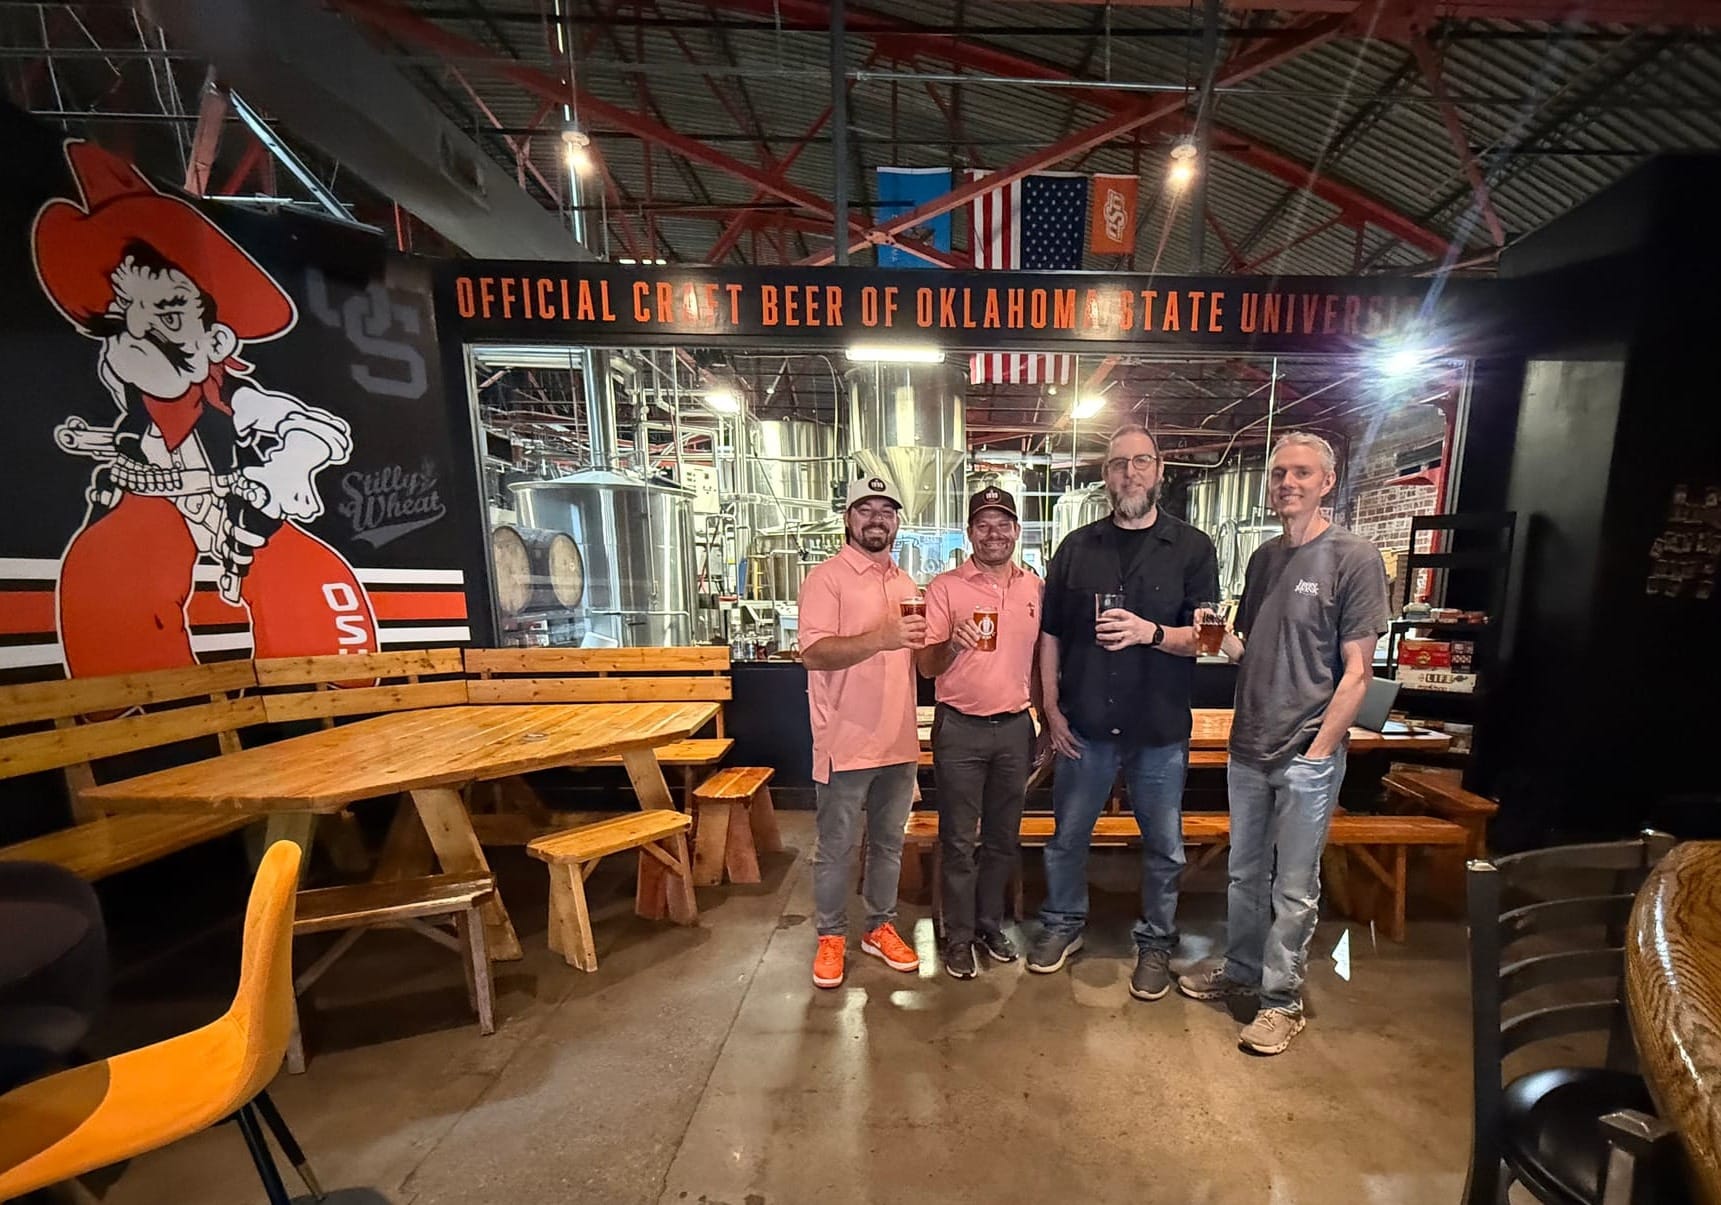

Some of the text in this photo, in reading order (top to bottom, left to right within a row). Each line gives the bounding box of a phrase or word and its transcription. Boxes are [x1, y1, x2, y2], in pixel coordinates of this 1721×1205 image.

[456, 277, 616, 321] OFFICIAL
[632, 281, 743, 326] CRAFT
[761, 284, 843, 327] BEER
[861, 286, 899, 327] OF
[916, 287, 1103, 331] OKLAHOMA
[1118, 289, 1225, 332] STATE
[338, 489, 441, 531] Wheat
